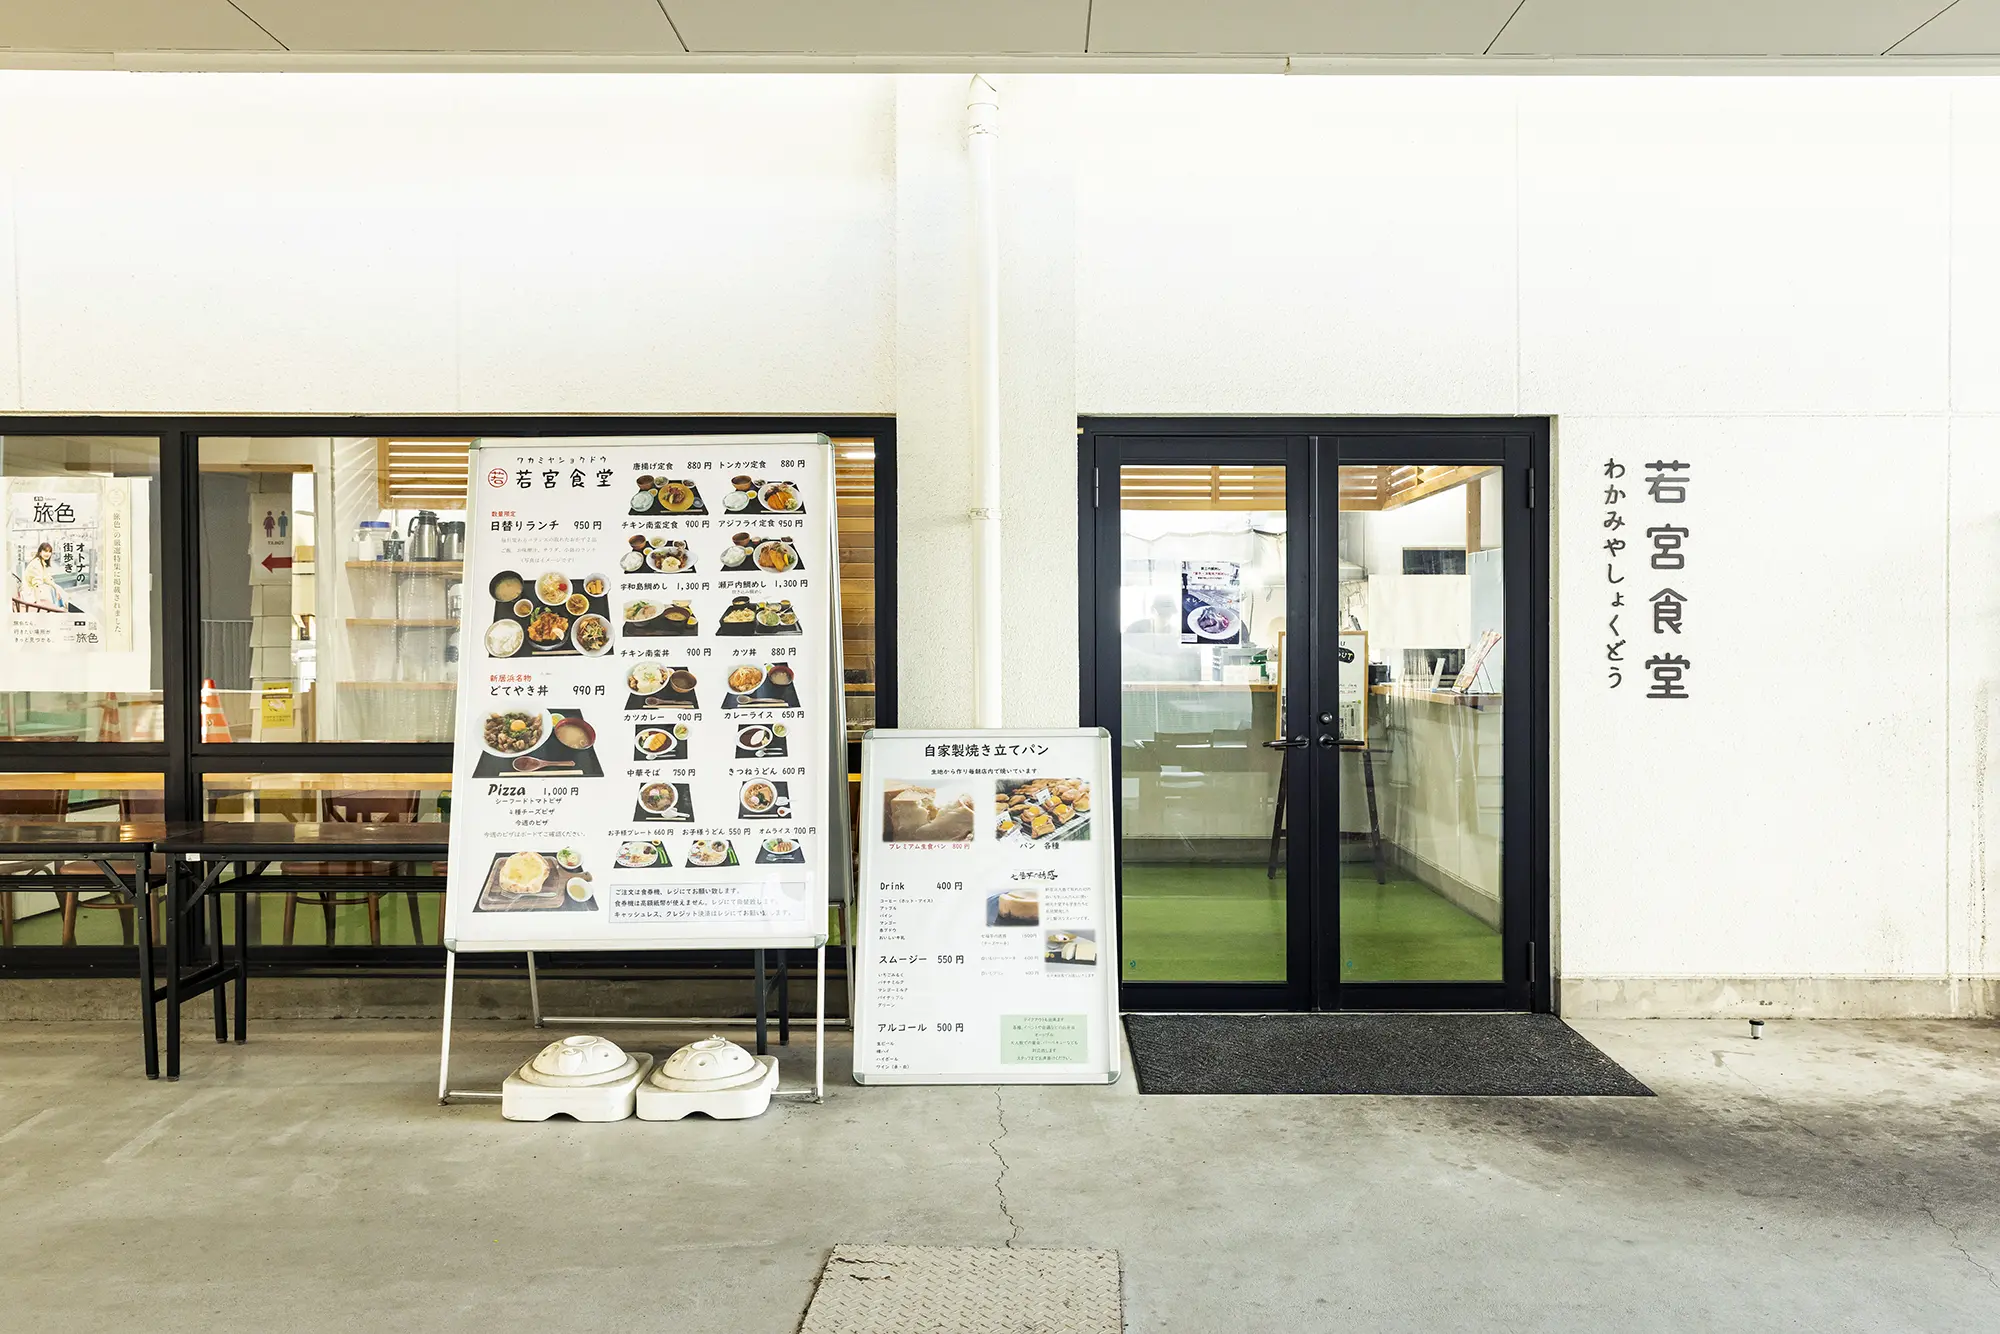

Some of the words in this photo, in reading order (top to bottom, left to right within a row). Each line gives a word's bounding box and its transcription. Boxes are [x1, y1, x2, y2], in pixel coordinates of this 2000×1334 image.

[517, 456, 608, 464] ワカミヤショクドウ
[798, 460, 805, 468] 円
[633, 462, 673, 470] 唐揚げ定食
[687, 461, 701, 469] 880
[704, 462, 712, 470] 円
[516, 469, 613, 488] 若宮食堂
[34, 503, 75, 524] 旅色
[491, 520, 559, 531] 日替りランチ
[574, 521, 589, 529] 950
[593, 521, 601, 530] 円
[622, 521, 678, 529] チキン南蛮定食
[685, 520, 699, 528] 900
[702, 520, 709, 528] 円
[719, 519, 775, 527] アジフライ定食
[63, 543, 74, 573] 街歩き
[75, 543, 85, 582] オトナの
[1603, 458, 1626, 688] わかみやしょくどう
[718, 581, 766, 589] 瀬戸内鯛めし
[775, 580, 797, 588] 1,300
[800, 579, 808, 587] 円
[1645, 460, 1690, 699] 若宮食堂
[677, 582, 699, 590] 1,300
[702, 582, 709, 590] 円
[76, 633, 98, 643] 旅色
[621, 649, 669, 657] チキン南蛮丼
[687, 648, 700, 656] 900
[704, 648, 711, 656] 円
[771, 648, 785, 656] 880
[789, 647, 796, 656] 円
[490, 674, 532, 682] 新居浜名物
[491, 685, 548, 696] どてやき丼
[573, 686, 591, 695] 990
[595, 685, 604, 695] 円
[677, 713, 691, 721] 900
[694, 713, 702, 721] 円
[725, 711, 773, 719] カレーライス
[925, 744, 1048, 757] 自家製焼き立てパン
[627, 769, 660, 777] 中華そば
[729, 768, 777, 776] きつねうどん
[798, 767, 805, 775] 円
[488, 784, 525, 796] Pizza
[544, 787, 567, 796] 1,000
[571, 787, 578, 795] 円
[880, 882, 904, 890] Drink
[937, 882, 951, 890] 400
[955, 882, 962, 890] 円
[879, 955, 926, 964] スムージー
[938, 955, 952, 963] 550
[956, 955, 964, 964] 円
[878, 1024, 927, 1032] アルコール
[937, 1023, 952, 1032] 500
[956, 1023, 963, 1032] 円
